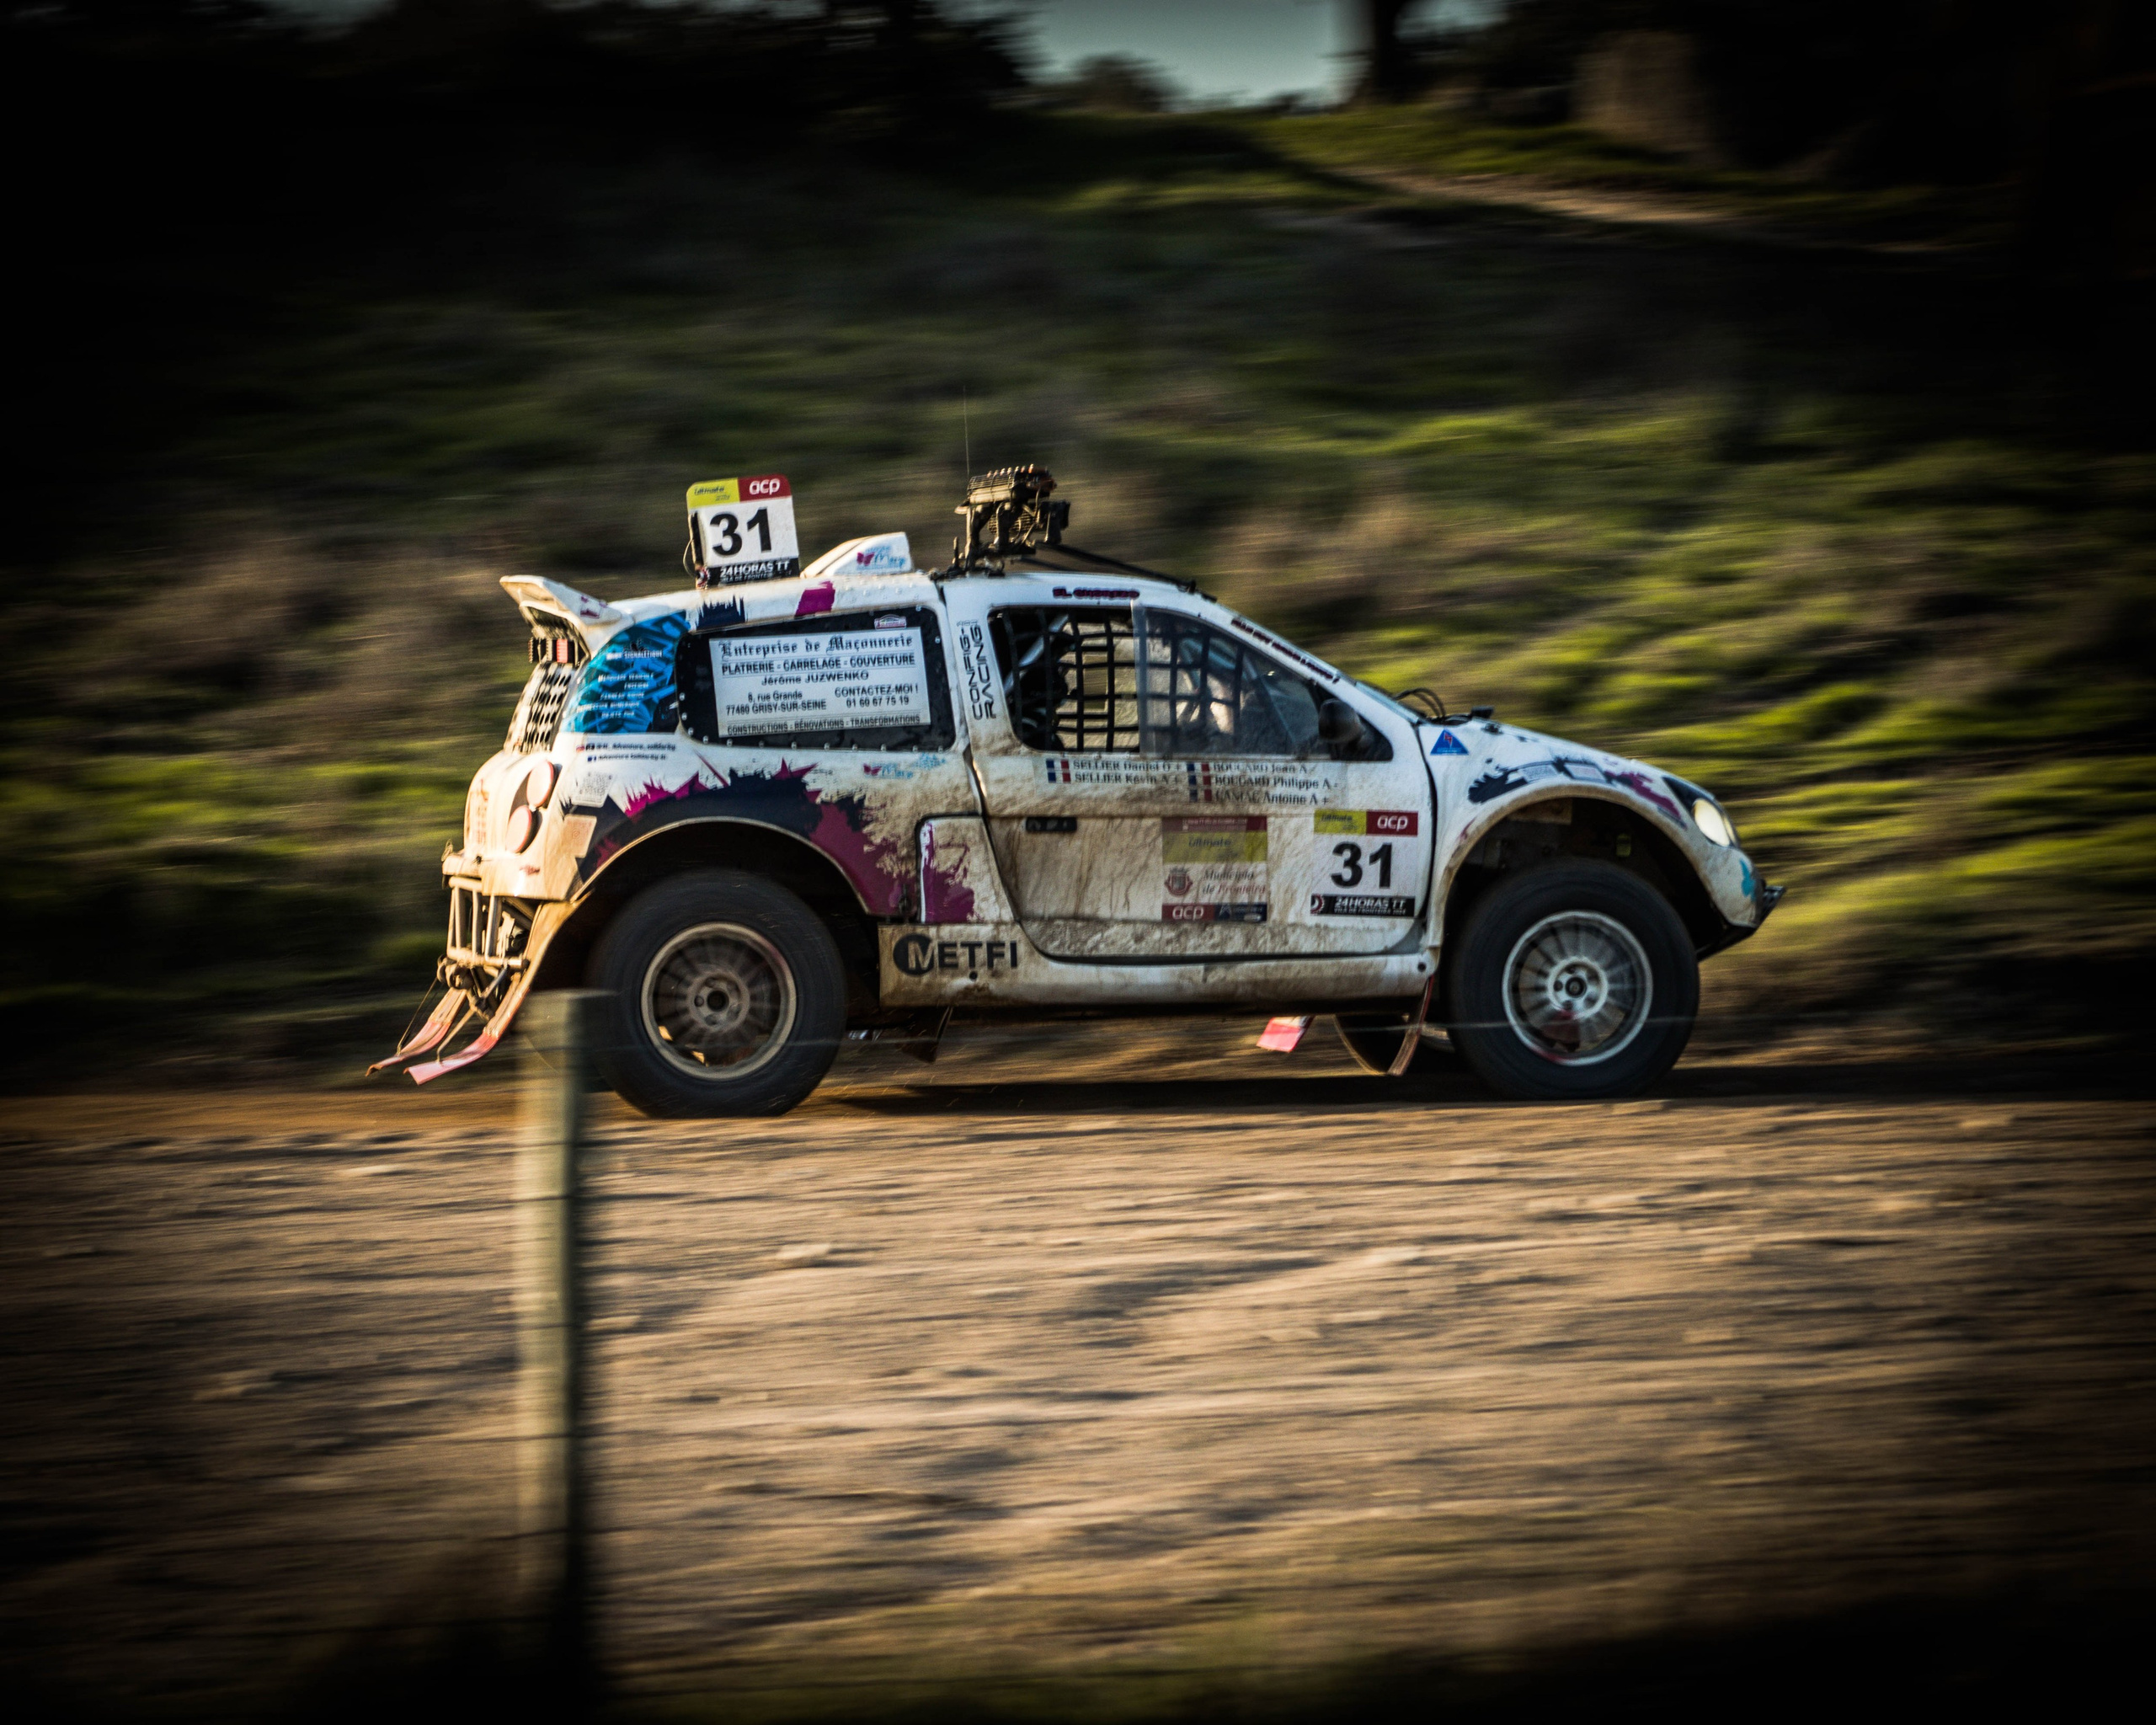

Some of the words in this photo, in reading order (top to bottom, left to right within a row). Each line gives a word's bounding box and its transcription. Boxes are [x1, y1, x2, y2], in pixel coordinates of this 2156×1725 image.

[749, 478, 780, 495] acp
[709, 507, 771, 556] 31
[775, 560, 790, 572] TT
[718, 639, 798, 660] Entreprise
[804, 638, 820, 652] de
[826, 633, 913, 655] Maçonnerie
[783, 657, 841, 672] CARRELAGE
[850, 652, 915, 668] COUVERTURE
[804, 670, 869, 684] JUZWENKO
[970, 624, 996, 719] RACING
[758, 693, 771, 702] rue
[772, 690, 803, 702] Grande
[846, 697, 857, 708] 01
[899, 694, 910, 705] 19
[727, 722, 788, 736] CONSTRUCTIONS
[851, 714, 921, 728] TRANSFORMATIONS
[1073, 760, 1120, 771] SELLIER
[1075, 772, 1122, 783] SELLIER
[1273, 777, 1320, 790] Philippe
[1262, 791, 1306, 805] Antoine
[1377, 814, 1408, 831] acp
[1331, 841, 1392, 889] 31
[1392, 899, 1406, 910] TT
[1172, 905, 1204, 921] acp
